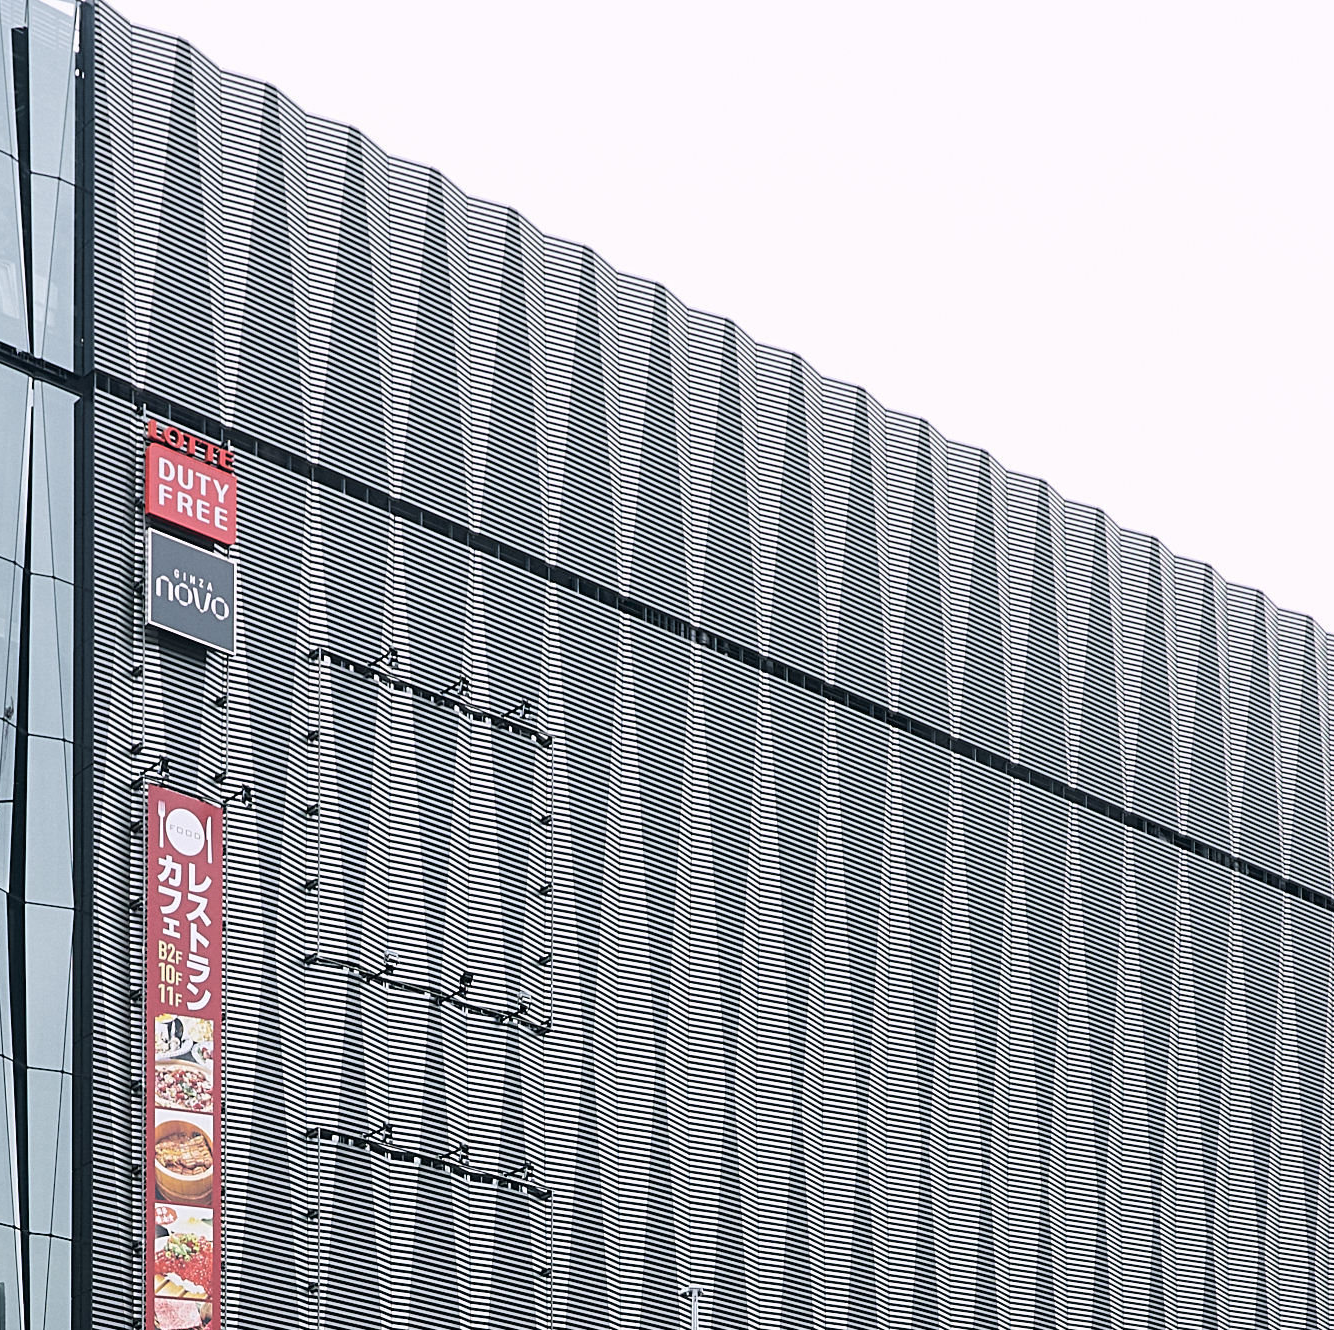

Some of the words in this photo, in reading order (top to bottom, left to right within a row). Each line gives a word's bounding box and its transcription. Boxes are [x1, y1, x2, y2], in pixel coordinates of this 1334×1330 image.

[147, 418, 235, 472] LOTTE
[158, 457, 229, 504] DUTY
[158, 483, 228, 531] FREE
[173, 568, 213, 592] GINZA
[169, 824, 201, 840] FOOD
[157, 854, 183, 940] カフェ
[157, 940, 183, 965] B2F
[185, 862, 212, 1011] レストラン
[157, 961, 183, 986] 10F
[157, 983, 183, 1008] 11F
